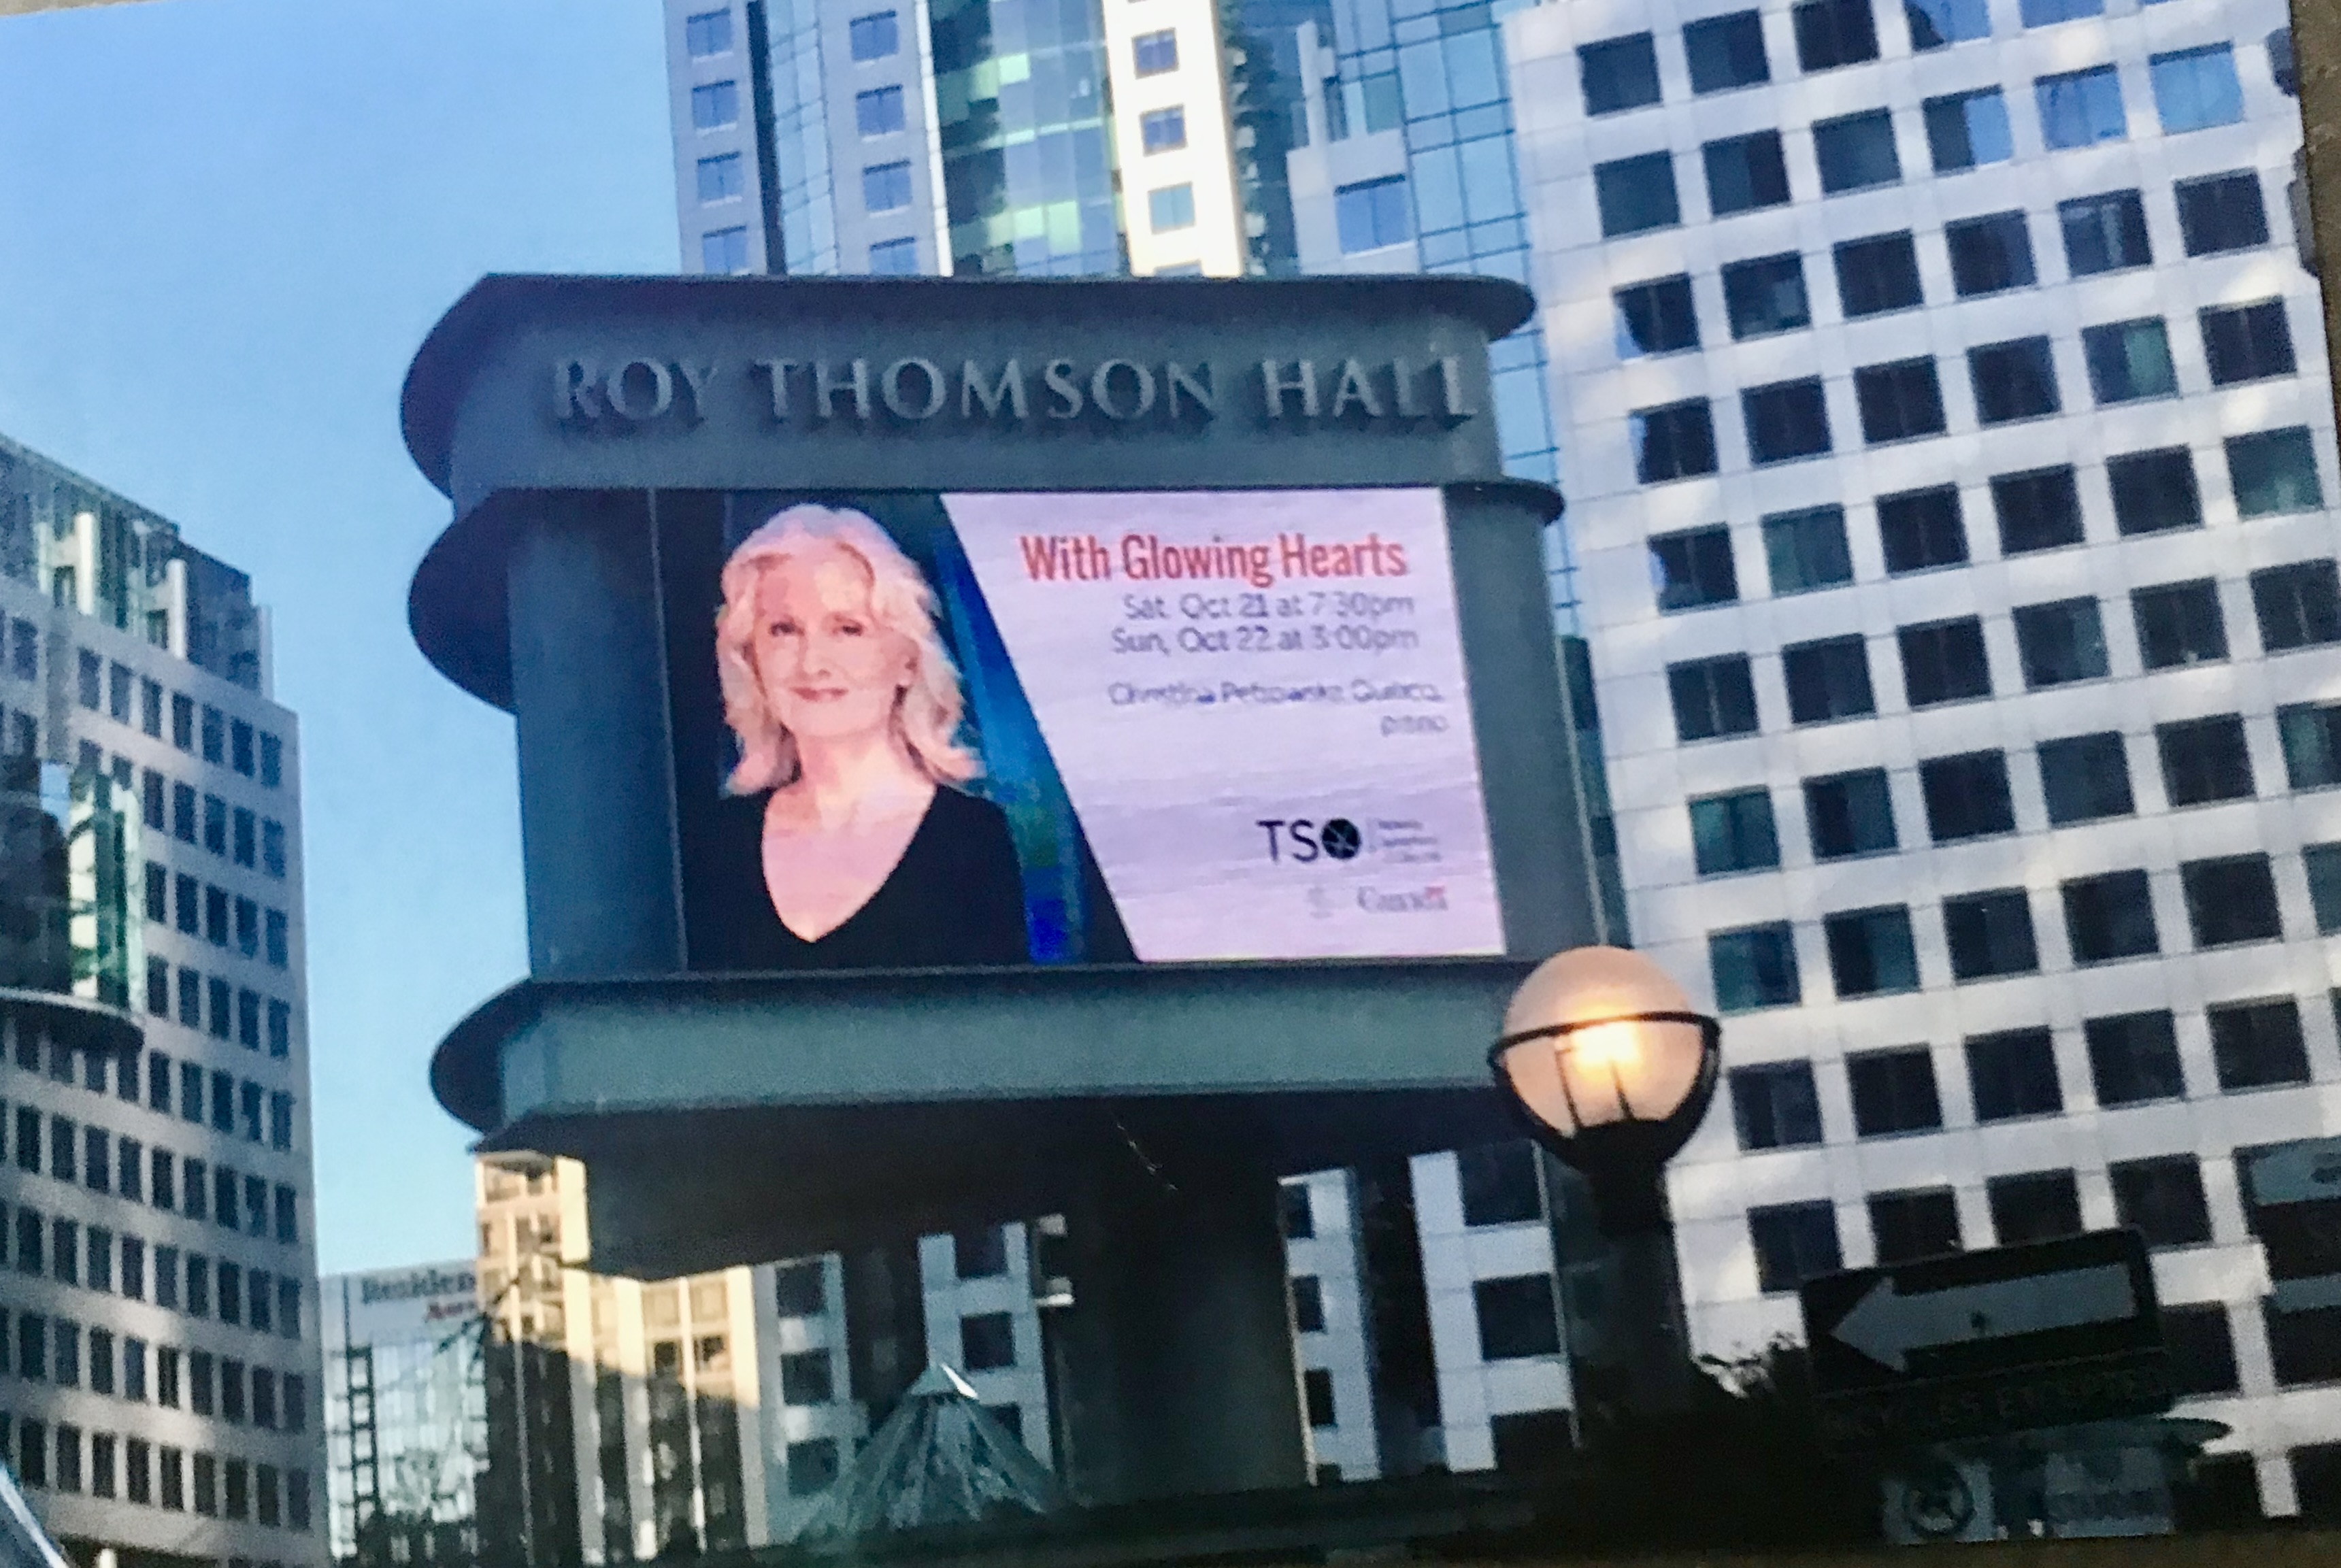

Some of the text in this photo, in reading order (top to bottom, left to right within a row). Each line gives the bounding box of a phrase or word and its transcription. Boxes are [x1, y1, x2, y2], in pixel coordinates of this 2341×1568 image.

[553, 354, 1479, 420] ROY THOMSON HALL
[1019, 532, 1409, 589] With Glowing Hearts
[1179, 593, 1231, 620] Oct
[1238, 593, 1270, 618] 21
[1276, 595, 1304, 618] at
[1308, 590, 1416, 623] 730pm
[1177, 627, 1231, 652] Oct
[1236, 625, 1276, 652] 22
[1278, 630, 1304, 651] at
